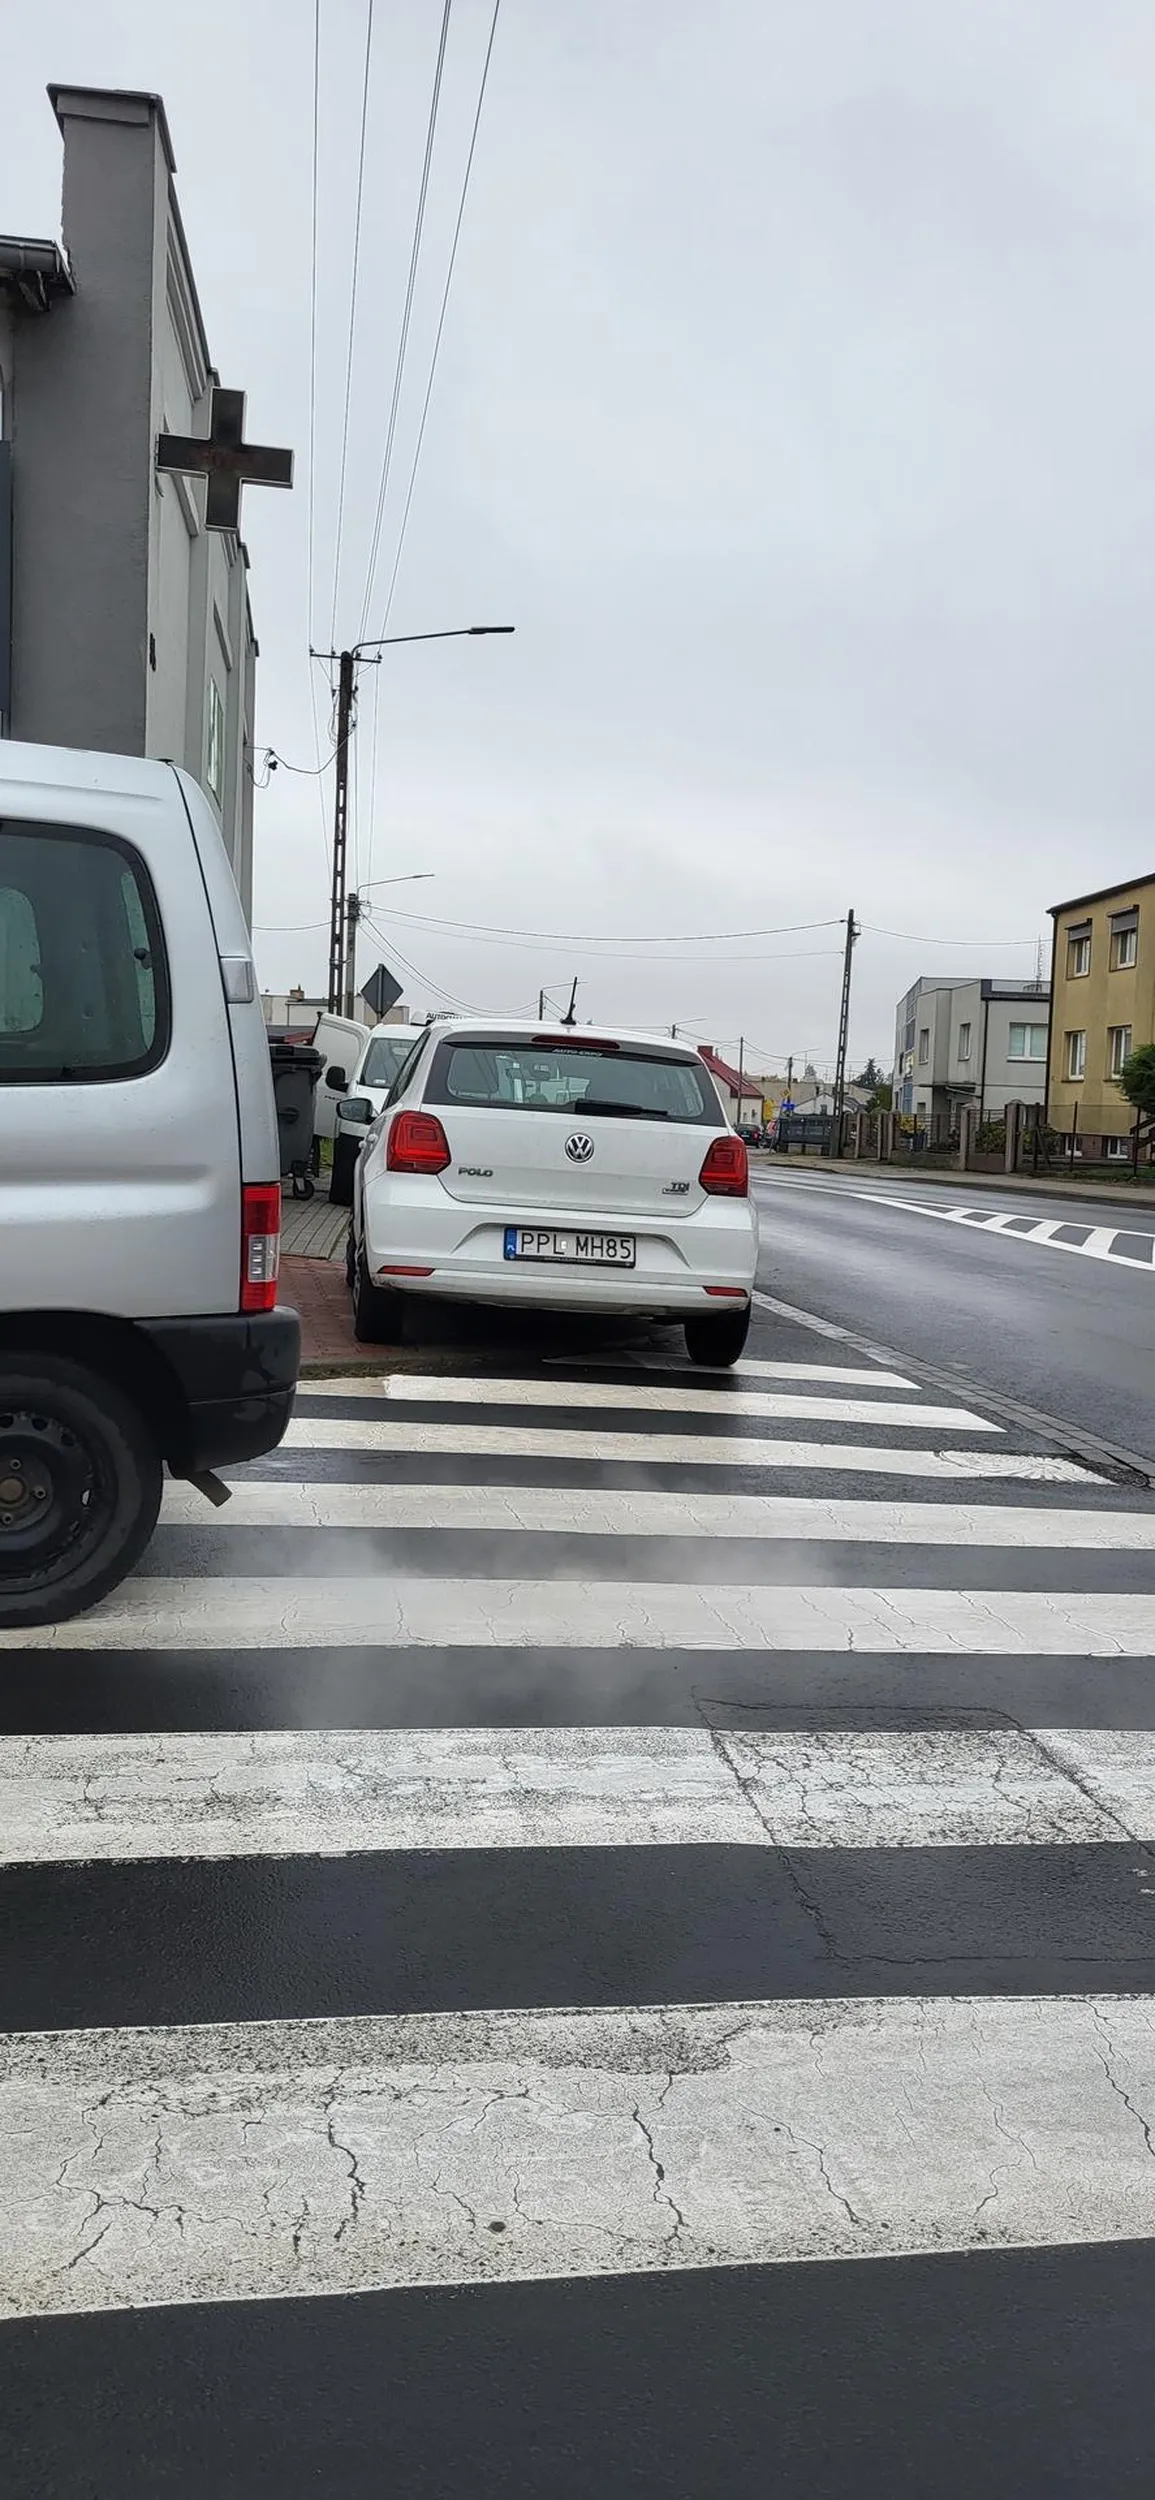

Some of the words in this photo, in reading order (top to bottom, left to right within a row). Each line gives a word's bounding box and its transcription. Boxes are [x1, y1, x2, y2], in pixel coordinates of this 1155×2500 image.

[458, 1167, 494, 1177] POLO
[521, 1232, 564, 1255] PPL
[576, 1235, 632, 1259] MH85
